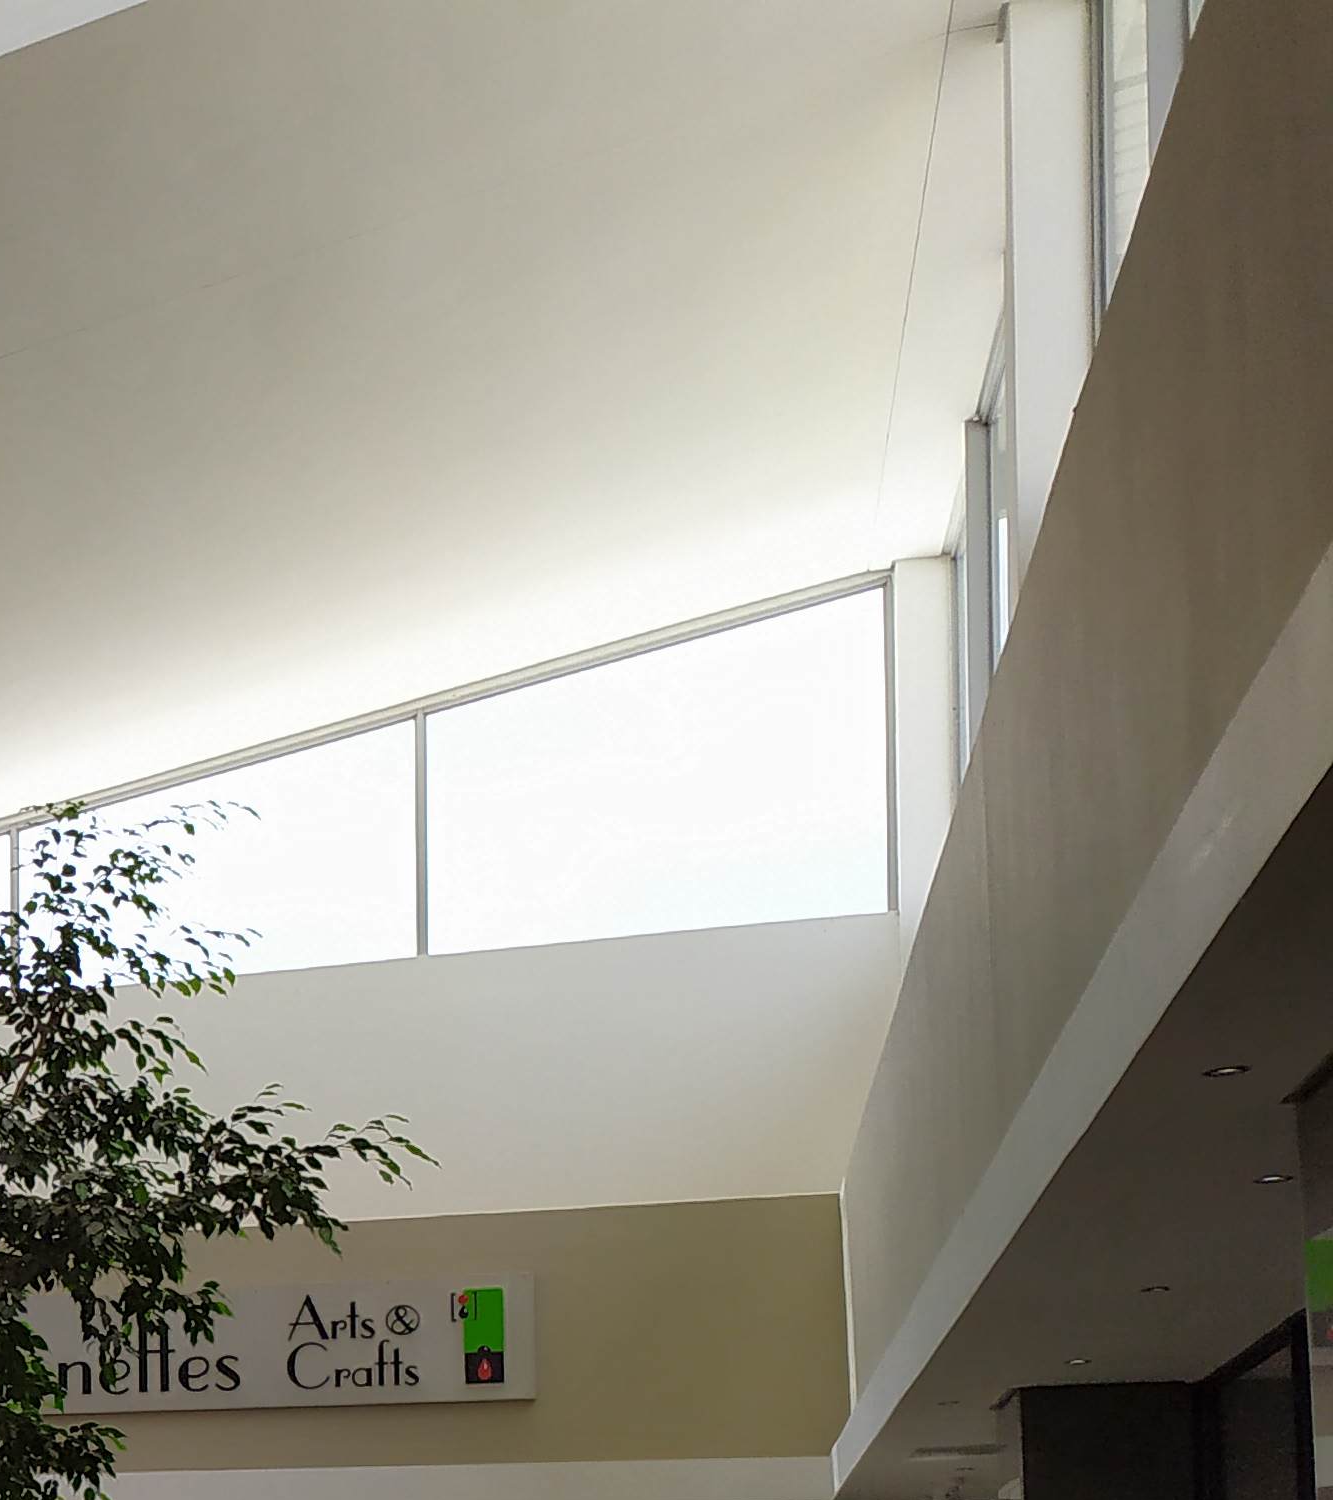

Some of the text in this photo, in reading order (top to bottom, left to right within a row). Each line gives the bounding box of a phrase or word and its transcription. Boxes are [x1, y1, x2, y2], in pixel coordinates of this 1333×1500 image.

[287, 1293, 421, 1342] Arts &
[57, 1311, 242, 1396] nettes
[286, 1338, 421, 1390] Crafts
